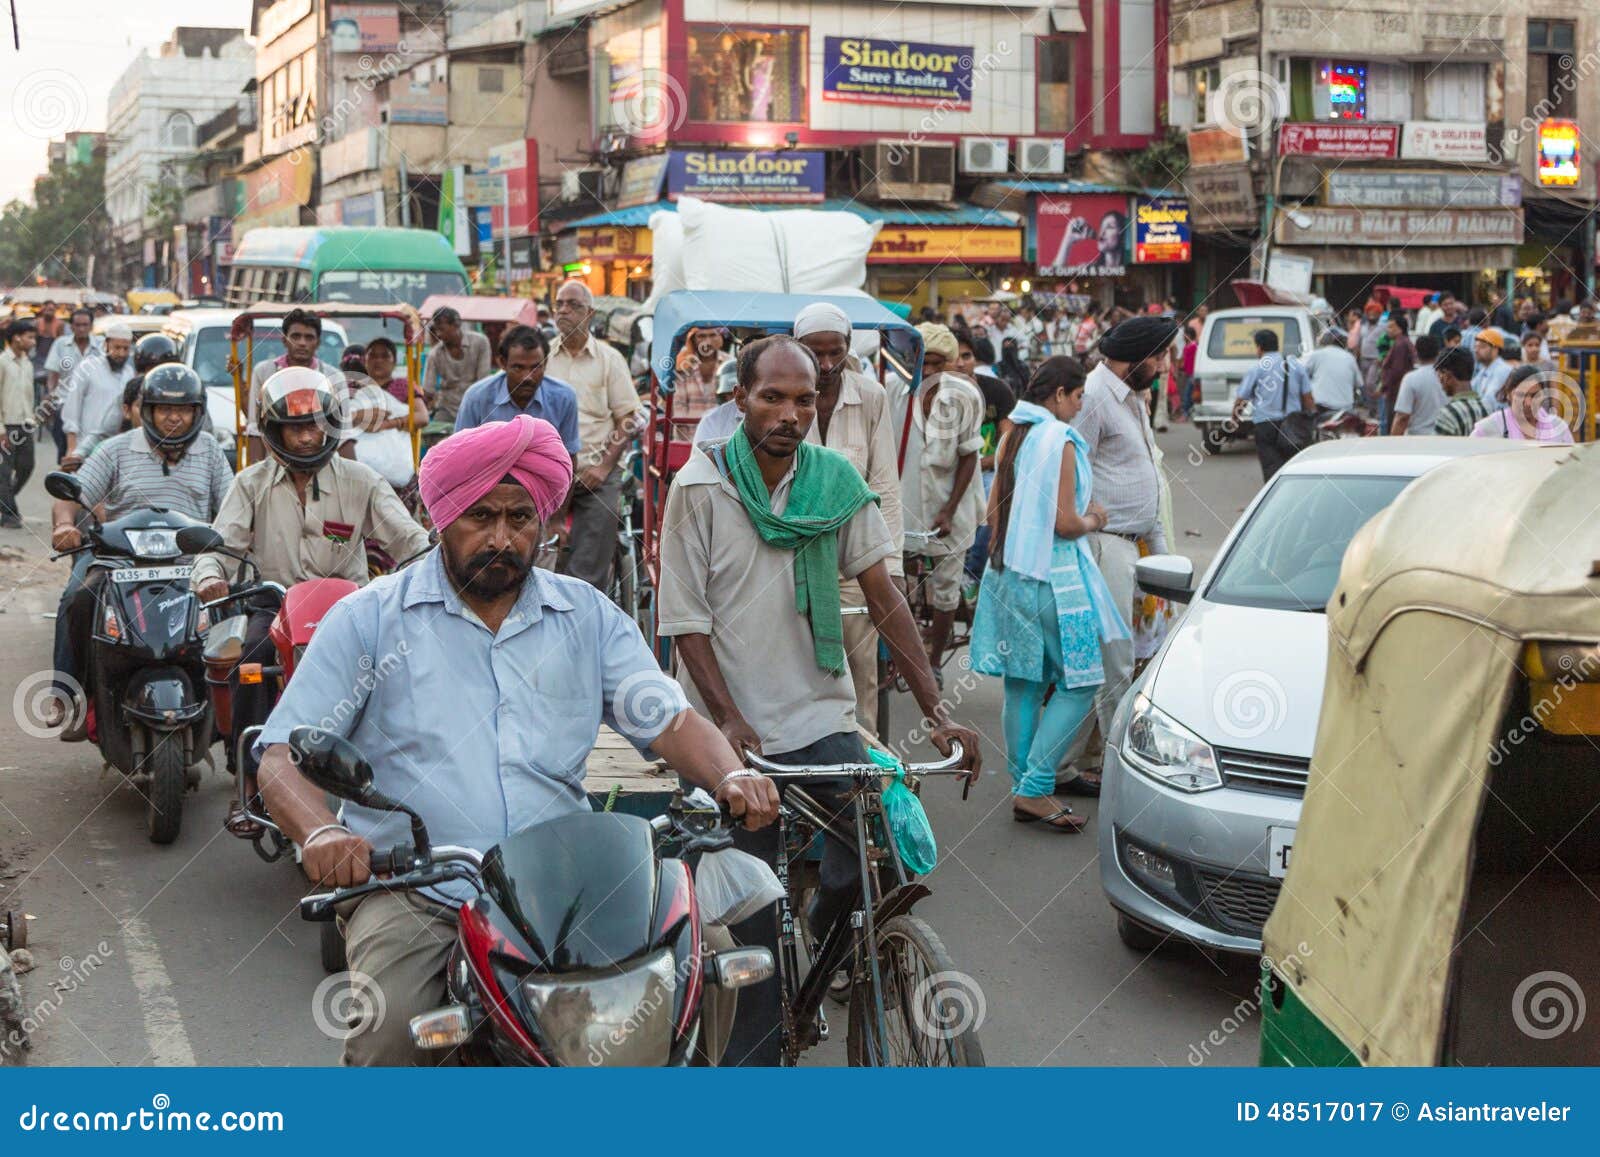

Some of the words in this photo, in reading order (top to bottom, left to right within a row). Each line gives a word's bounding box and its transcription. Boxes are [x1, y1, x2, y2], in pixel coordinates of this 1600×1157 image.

[840, 39, 958, 72] Sindoor
[849, 67, 892, 83] Saree
[895, 70, 948, 89] Kendra
[685, 152, 808, 174] Sindoor
[743, 174, 798, 186] Kendra
[1360, 215, 1400, 232] WALA
[1407, 215, 1453, 233] SHAHI
[1457, 215, 1514, 233] HALWAI
[1055, 266, 1088, 277] GUPTA
[1098, 266, 1126, 277] SONS
[149, 569, 160, 578] BY
